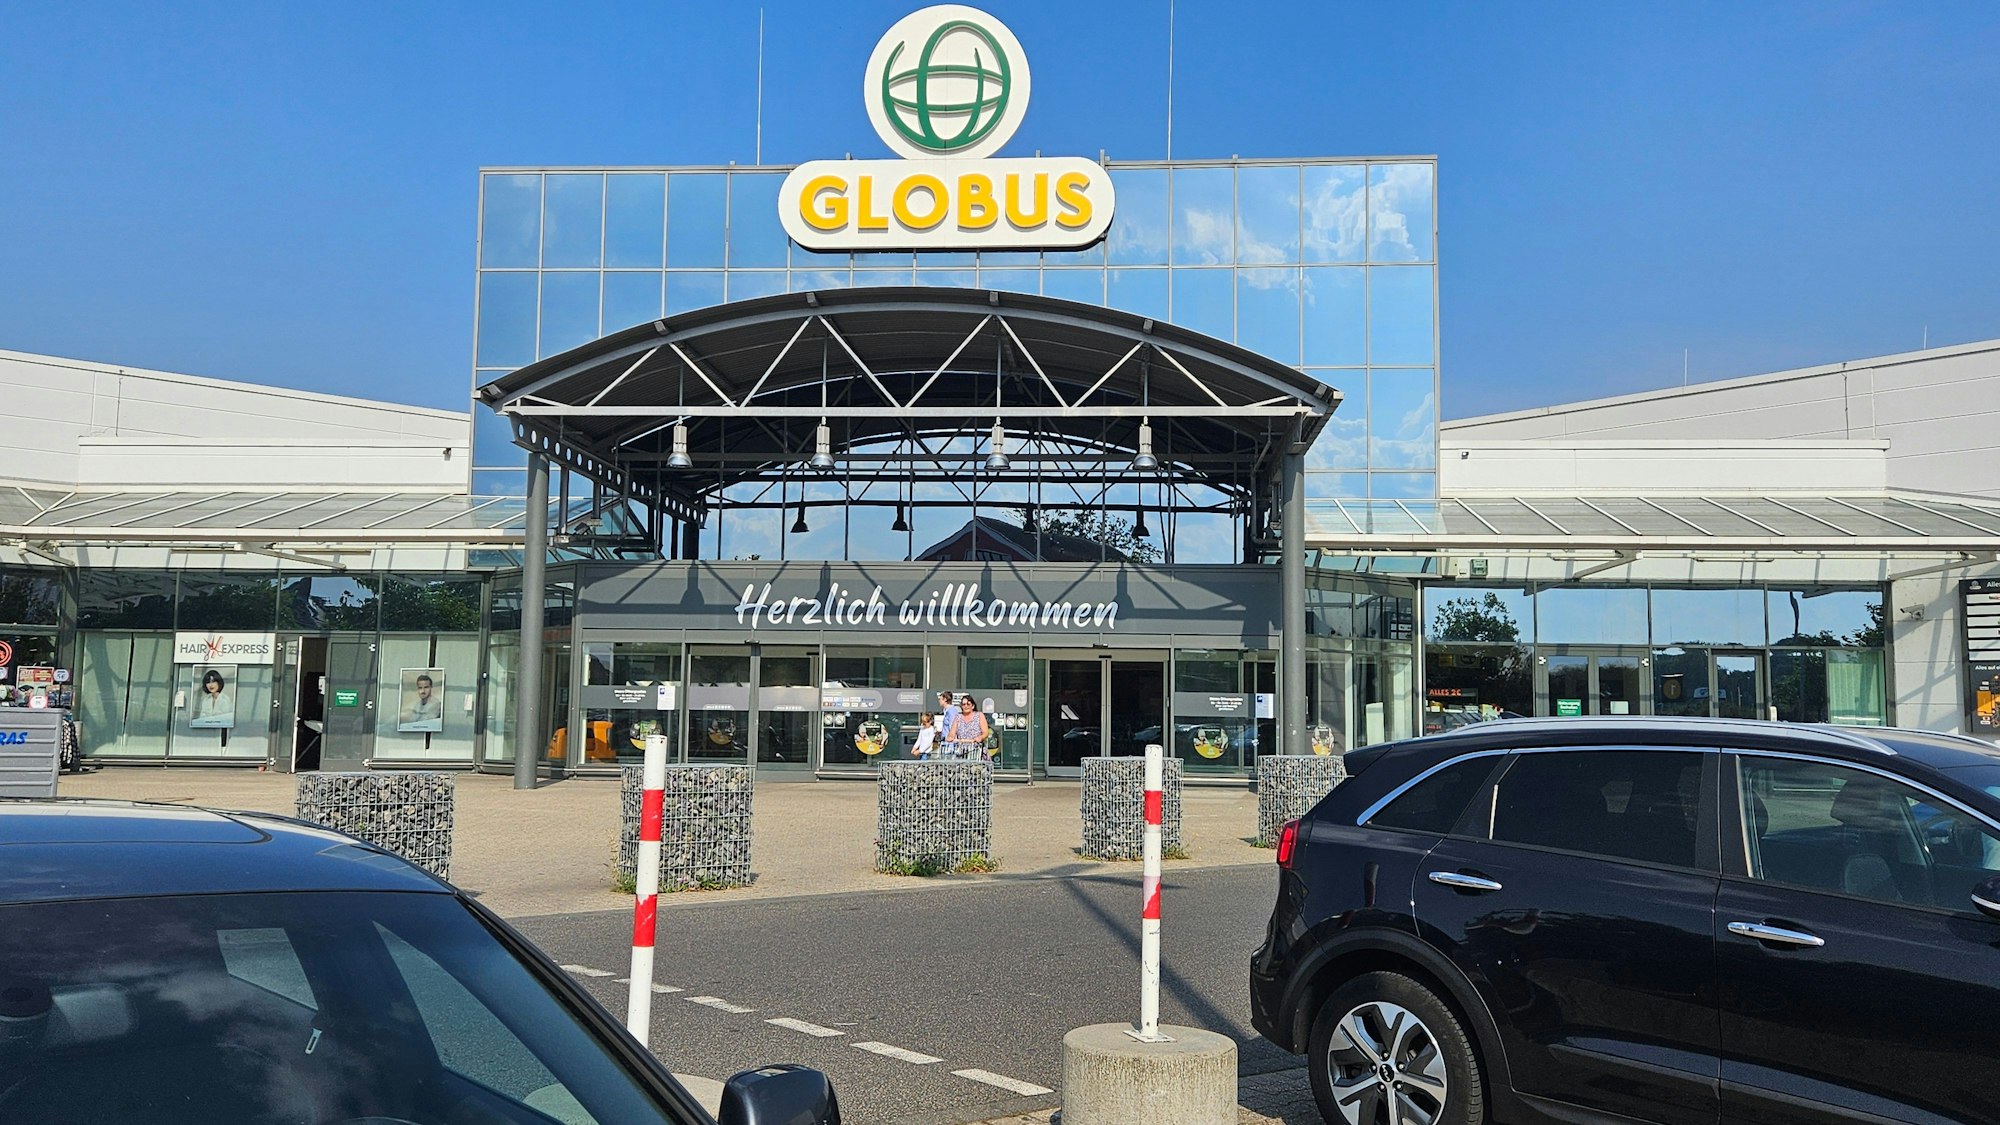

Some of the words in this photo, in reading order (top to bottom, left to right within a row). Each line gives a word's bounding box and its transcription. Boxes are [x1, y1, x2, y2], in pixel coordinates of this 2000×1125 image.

[799, 171, 1093, 231] GLOBUS
[1986, 580, 2000, 588] Alle
[734, 582, 885, 630] Herzlich
[898, 582, 1120, 630] willkommen
[179, 643, 208, 654] HAIR
[221, 643, 270, 655] EXPRESS
[1429, 688, 1450, 696] ALLES
